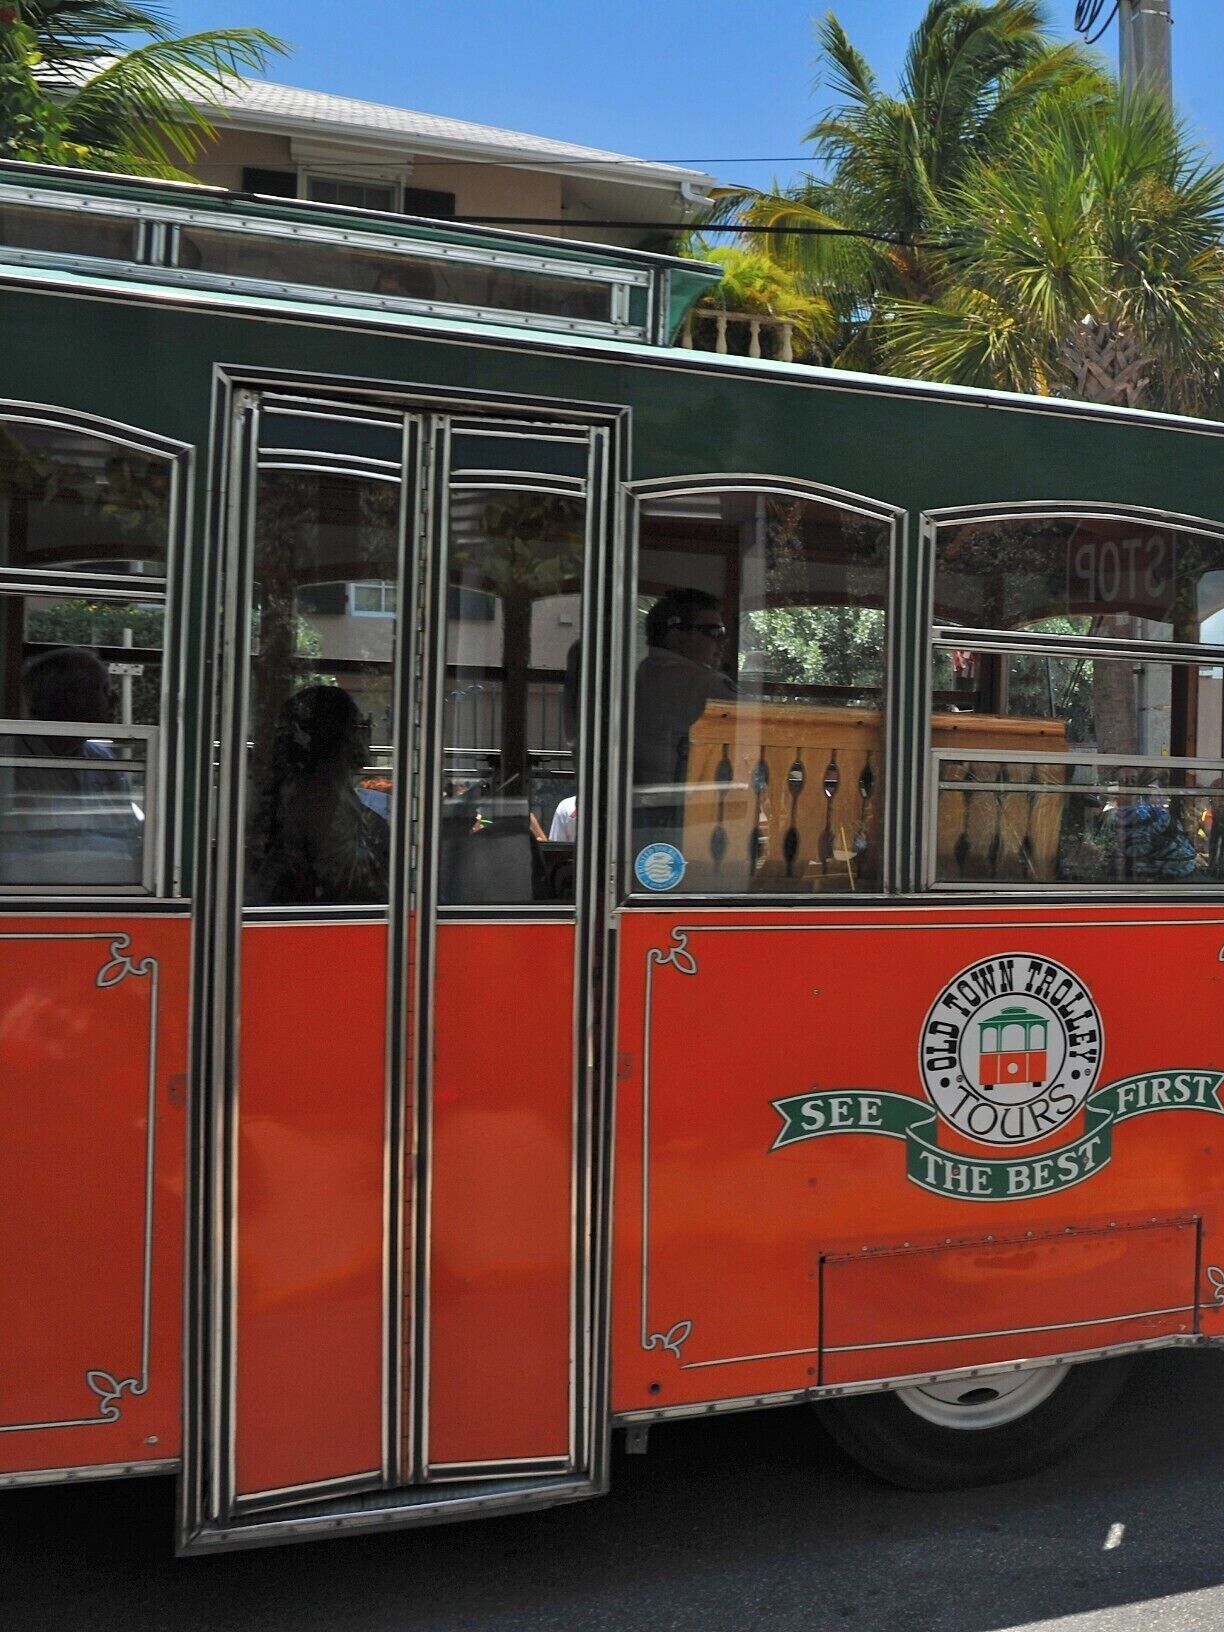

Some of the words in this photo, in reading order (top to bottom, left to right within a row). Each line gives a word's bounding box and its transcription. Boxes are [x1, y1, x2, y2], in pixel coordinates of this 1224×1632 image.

[942, 959, 1014, 1018] TOWN
[1025, 960, 1097, 1064] TROLLEY
[926, 1020, 960, 1072] OLD
[800, 1097, 883, 1131] SEE
[919, 1150, 993, 1195] THE
[1006, 1135, 1101, 1195] BEST
[1116, 1074, 1213, 1115] FIRST
[950, 1083, 1077, 1139] TOURS
